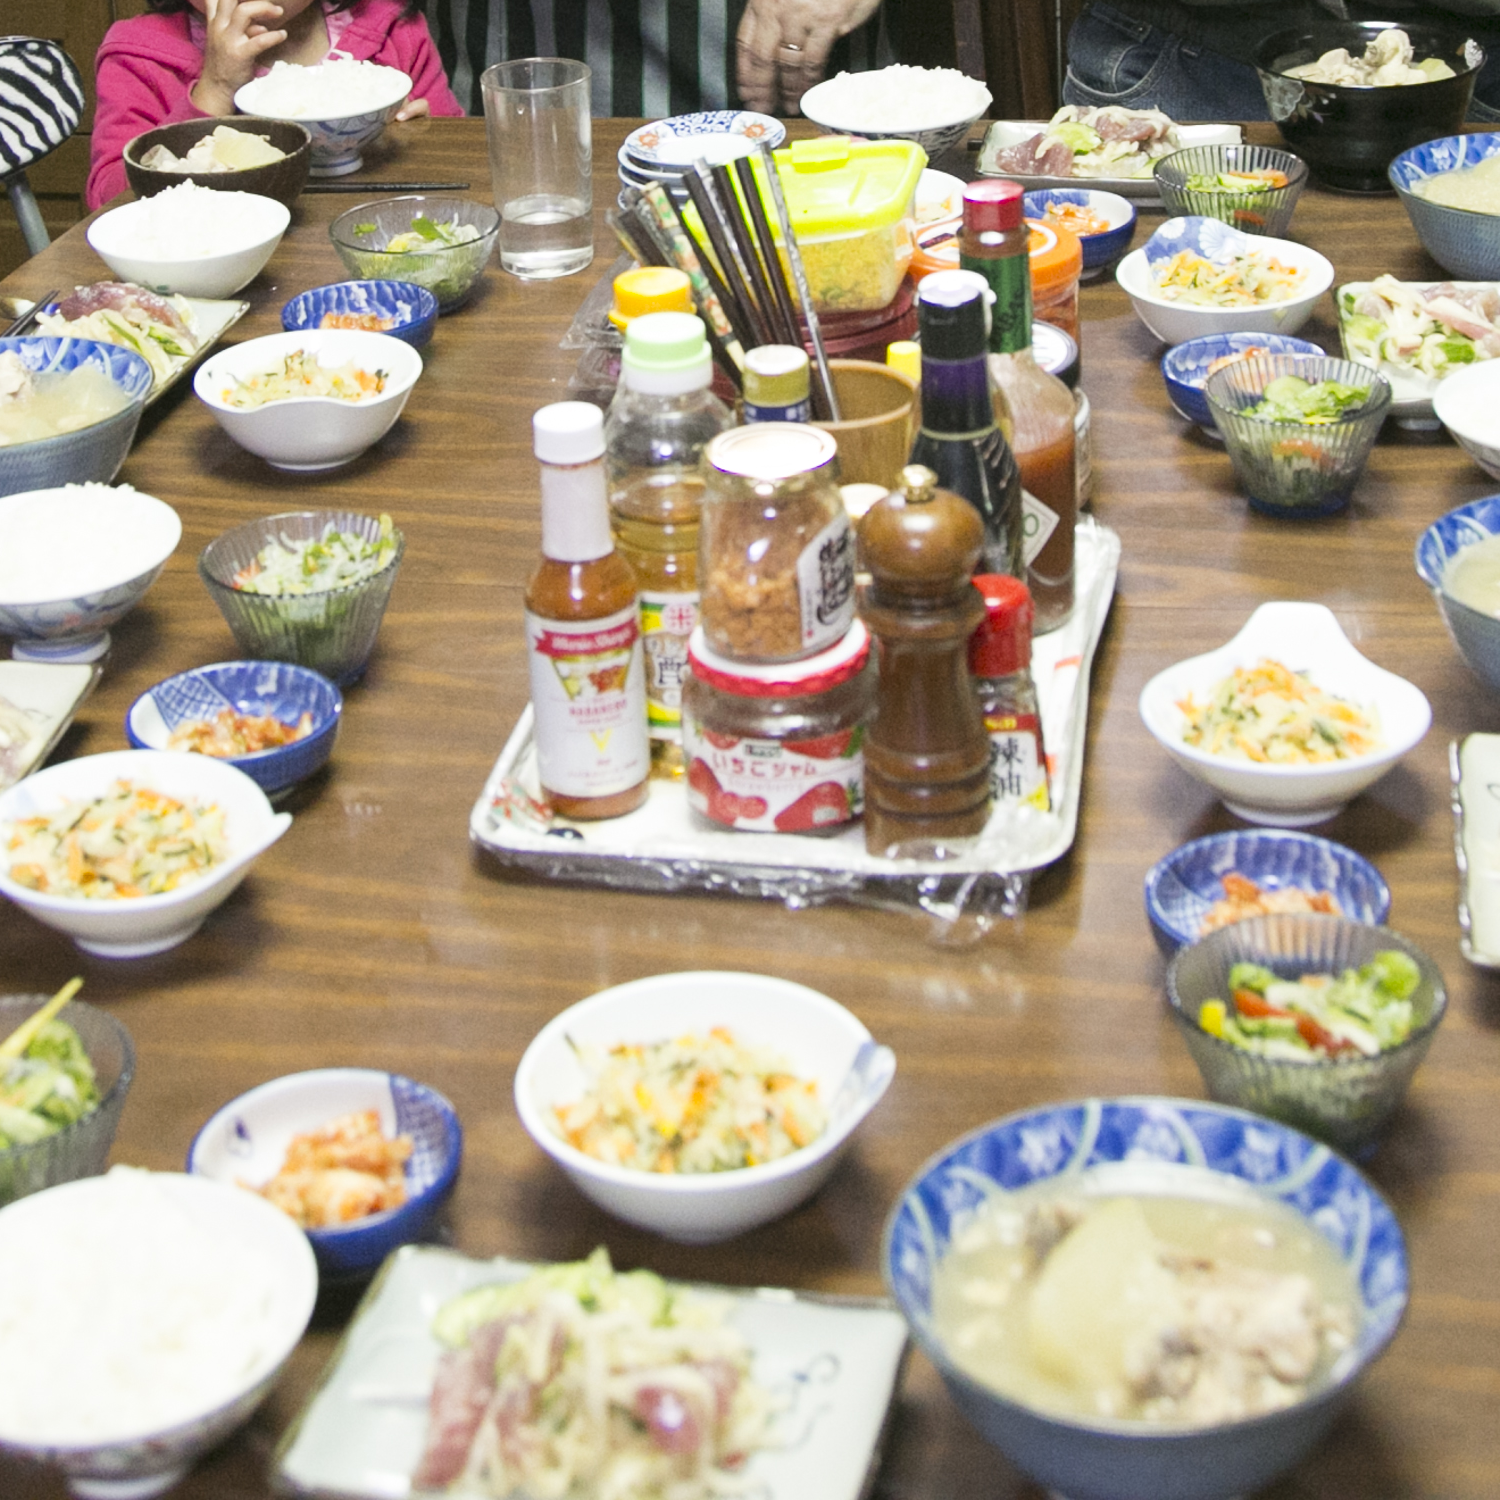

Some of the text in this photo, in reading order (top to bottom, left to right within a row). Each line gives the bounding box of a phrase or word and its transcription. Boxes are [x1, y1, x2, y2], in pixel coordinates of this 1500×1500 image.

[712, 752, 817, 779] いちごジャム
